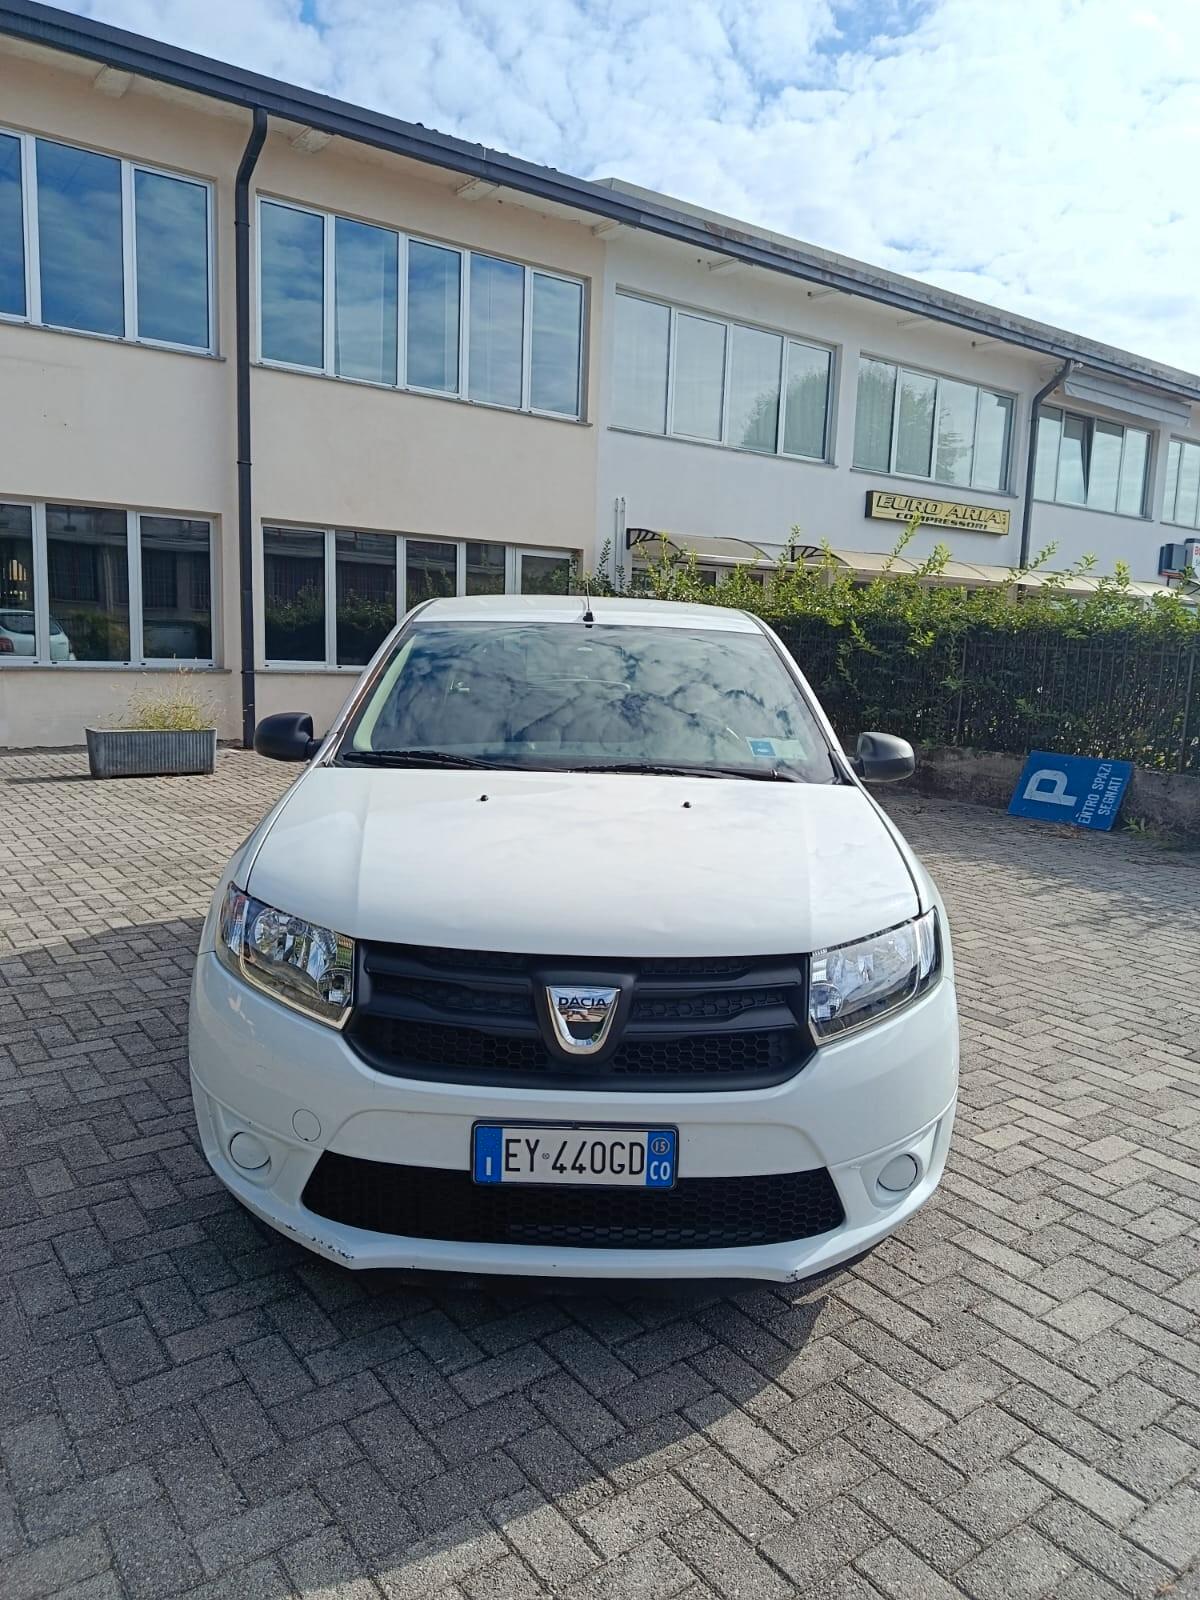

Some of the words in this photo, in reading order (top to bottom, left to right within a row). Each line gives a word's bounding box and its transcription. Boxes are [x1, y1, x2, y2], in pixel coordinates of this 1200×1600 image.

[876, 494, 942, 515] EURO
[945, 504, 1001, 525] ARIA
[1022, 769, 1078, 807] P
[1092, 763, 1113, 790] SPAZI
[1098, 777, 1123, 816] SEGNATI
[558, 996, 607, 1008] DACIA
[654, 1140, 666, 1152] 15
[650, 1161, 670, 1181] CO
